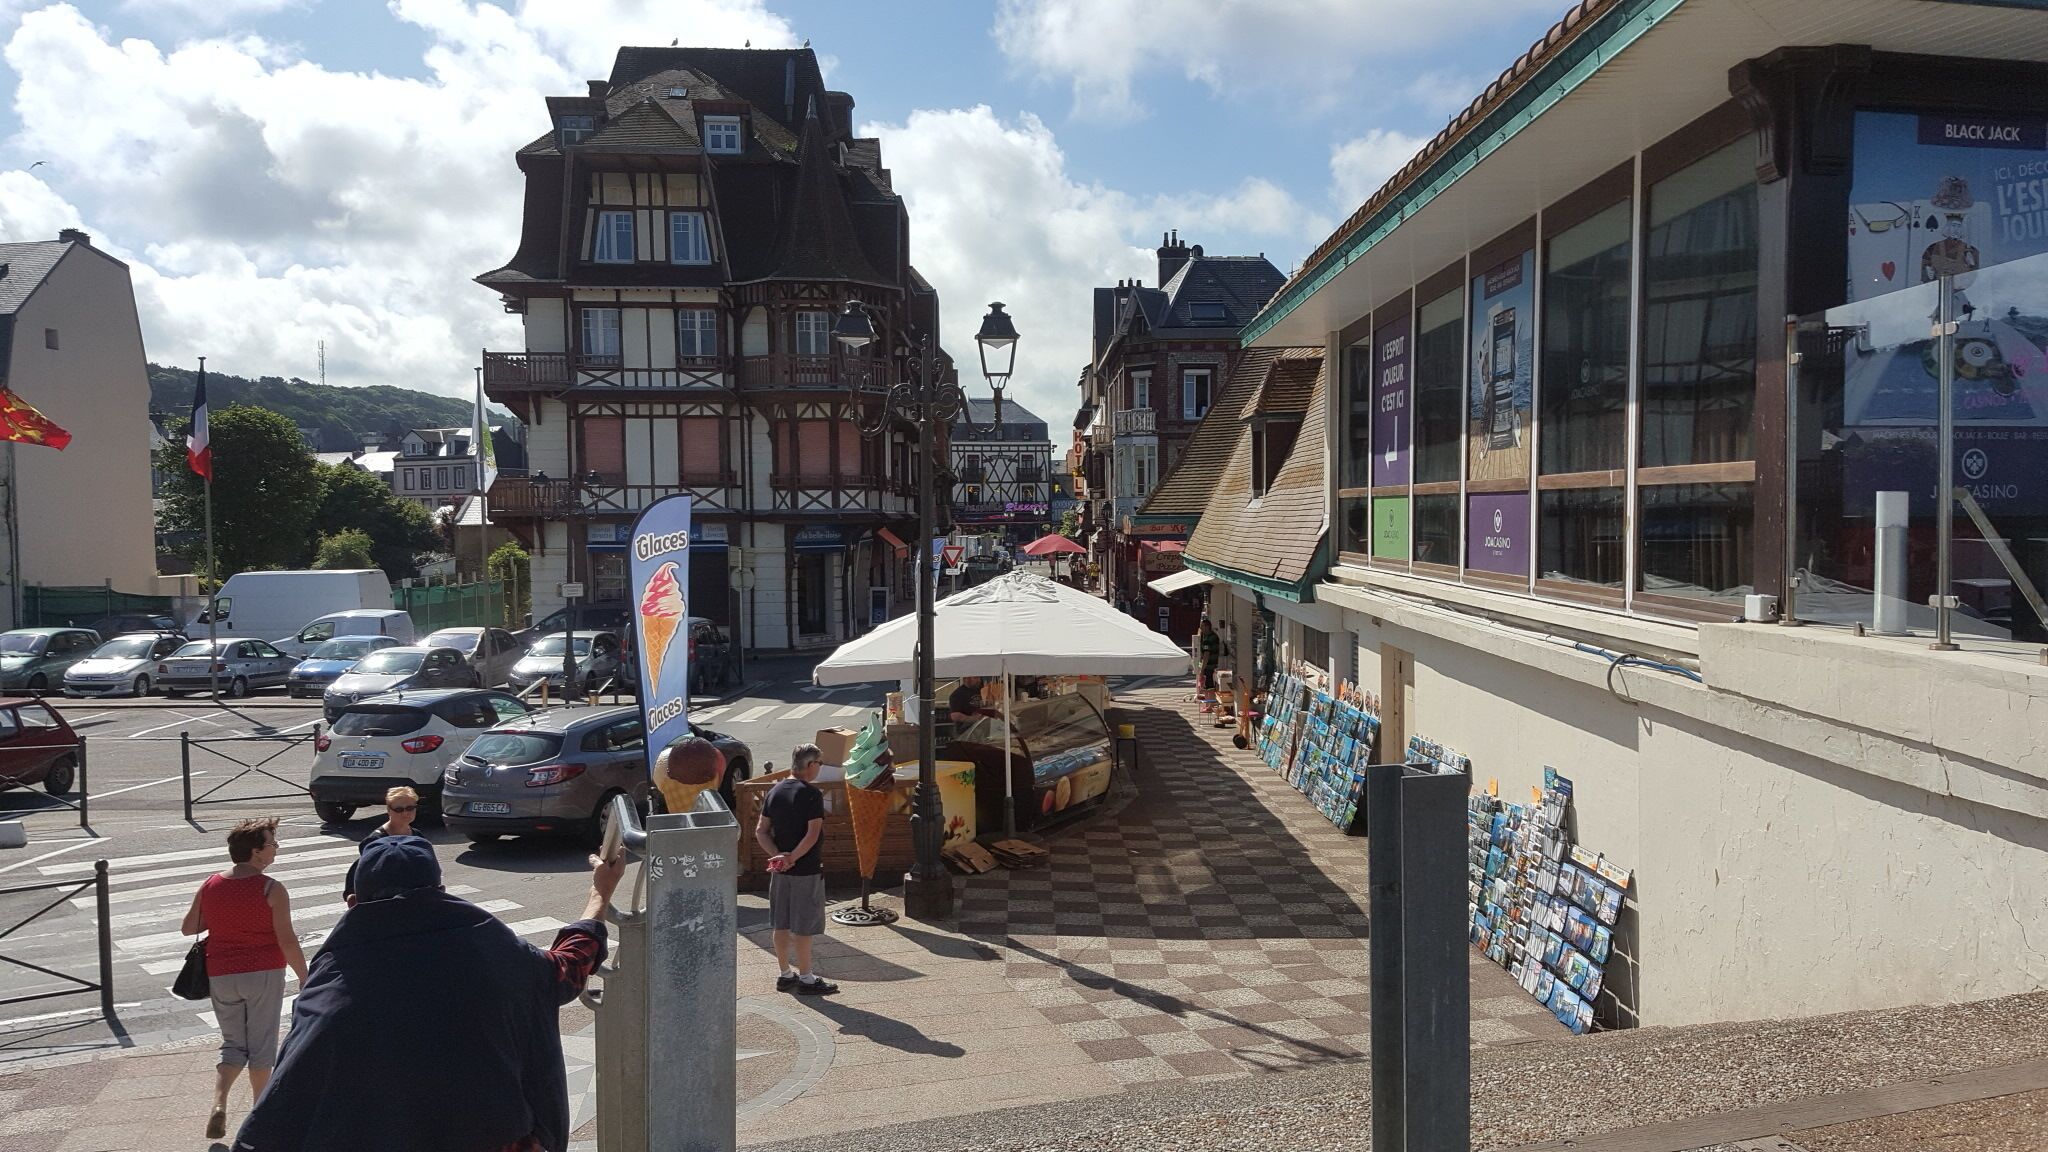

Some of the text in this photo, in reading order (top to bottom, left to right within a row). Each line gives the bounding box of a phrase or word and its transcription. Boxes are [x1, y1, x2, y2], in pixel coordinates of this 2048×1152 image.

[1945, 124, 2020, 141] BLACK JACK
[1382, 336, 1404, 362] L'ESPRIT
[1382, 363, 1404, 388] JOUEUR
[1381, 392, 1396, 413] C'EST
[1074, 431, 1083, 490] HOTL
[636, 531, 687, 560] Glaces
[1485, 536, 1511, 548] JOACASINO
[648, 697, 683, 733] Glaces
